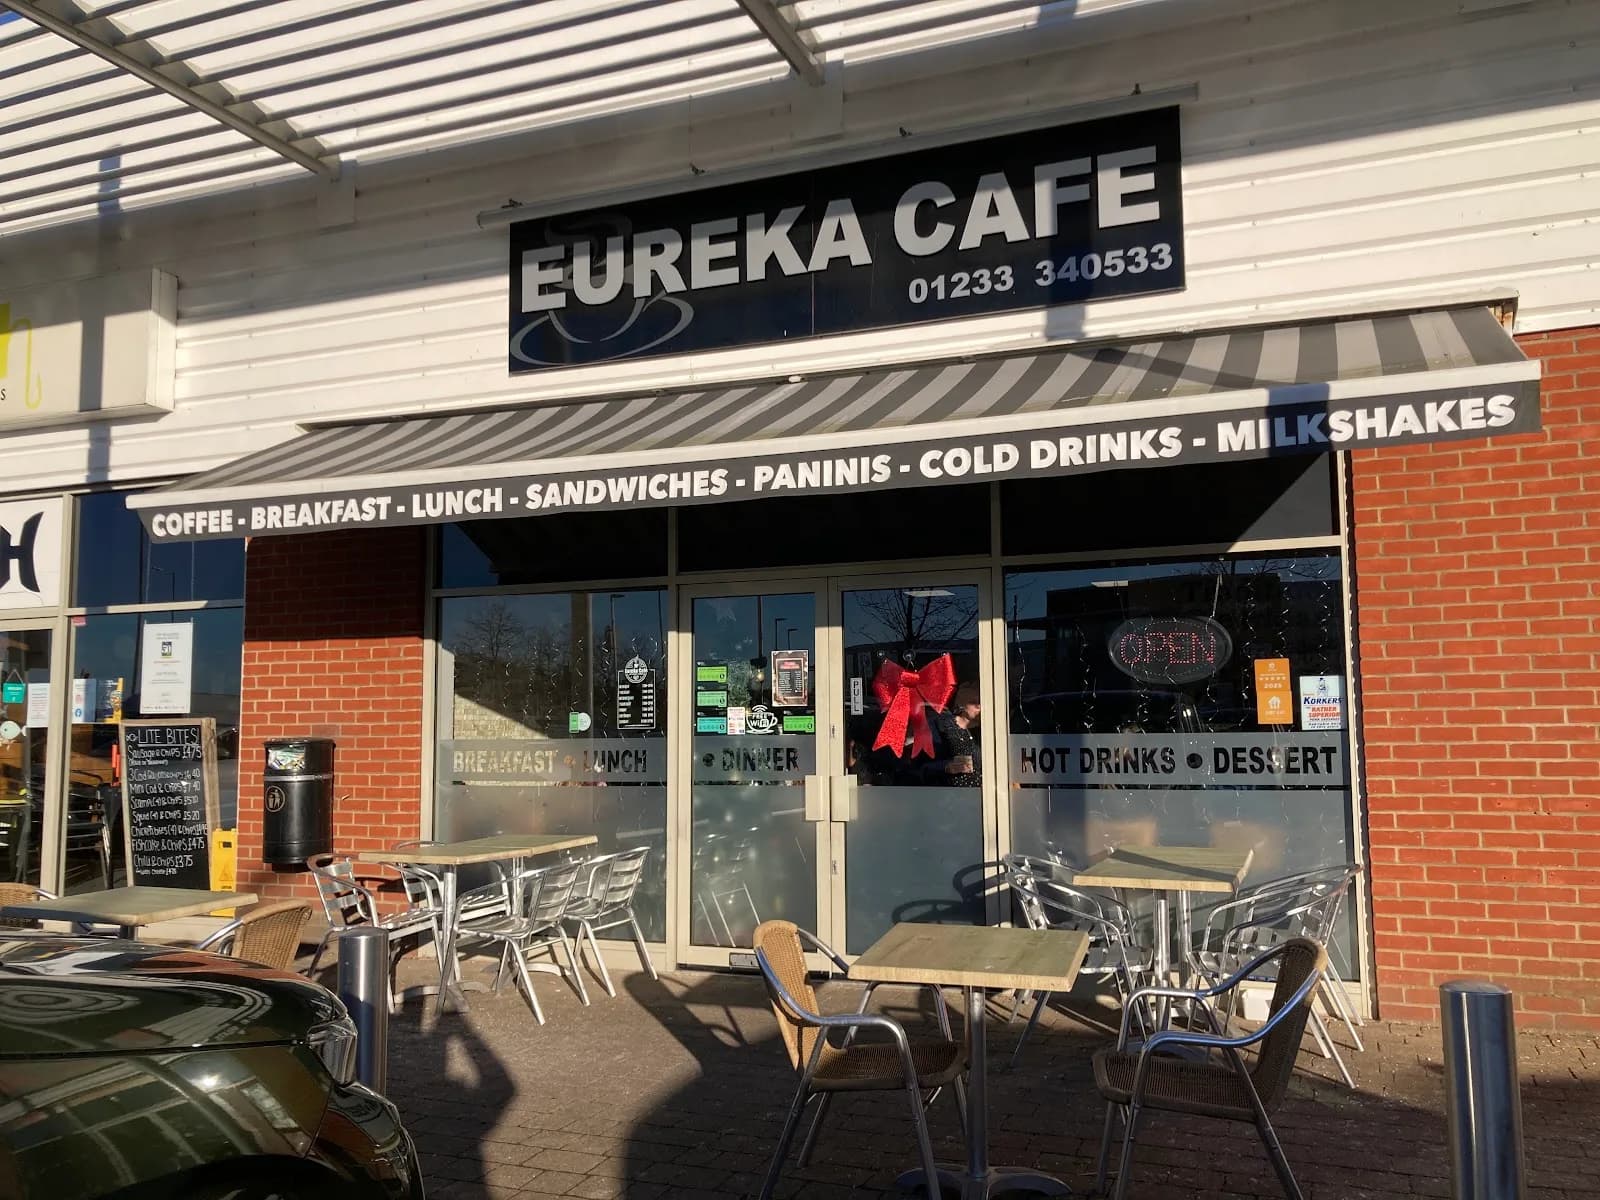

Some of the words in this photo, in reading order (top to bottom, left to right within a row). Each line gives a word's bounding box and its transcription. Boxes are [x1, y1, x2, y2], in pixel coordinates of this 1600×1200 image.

[522, 198, 872, 313] EUREKA
[893, 145, 1161, 257] CAFE
[908, 265, 1015, 304] 01233
[1034, 243, 1173, 287] 340533
[152, 509, 233, 537] COFFEE
[251, 497, 391, 530] BREAKFAST
[412, 488, 502, 518] LUNCH
[525, 468, 728, 510] SANDWICHES
[753, 454, 891, 492] PANINIS
[919, 443, 1020, 479] COLD
[1030, 427, 1182, 469] DRINKS
[1217, 394, 1516, 453] MILKSHAKES
[1120, 632, 1216, 664] OPEN
[1303, 696, 1344, 705] KORKERS
[138, 728, 160, 743] LITE
[452, 749, 555, 773] BREAKFAST
[583, 749, 647, 773] LUNCH
[722, 748, 800, 773] DINNER
[1021, 747, 1070, 774] HOT
[1079, 747, 1176, 774] DRINKS
[1214, 747, 1337, 774] DESSERT
